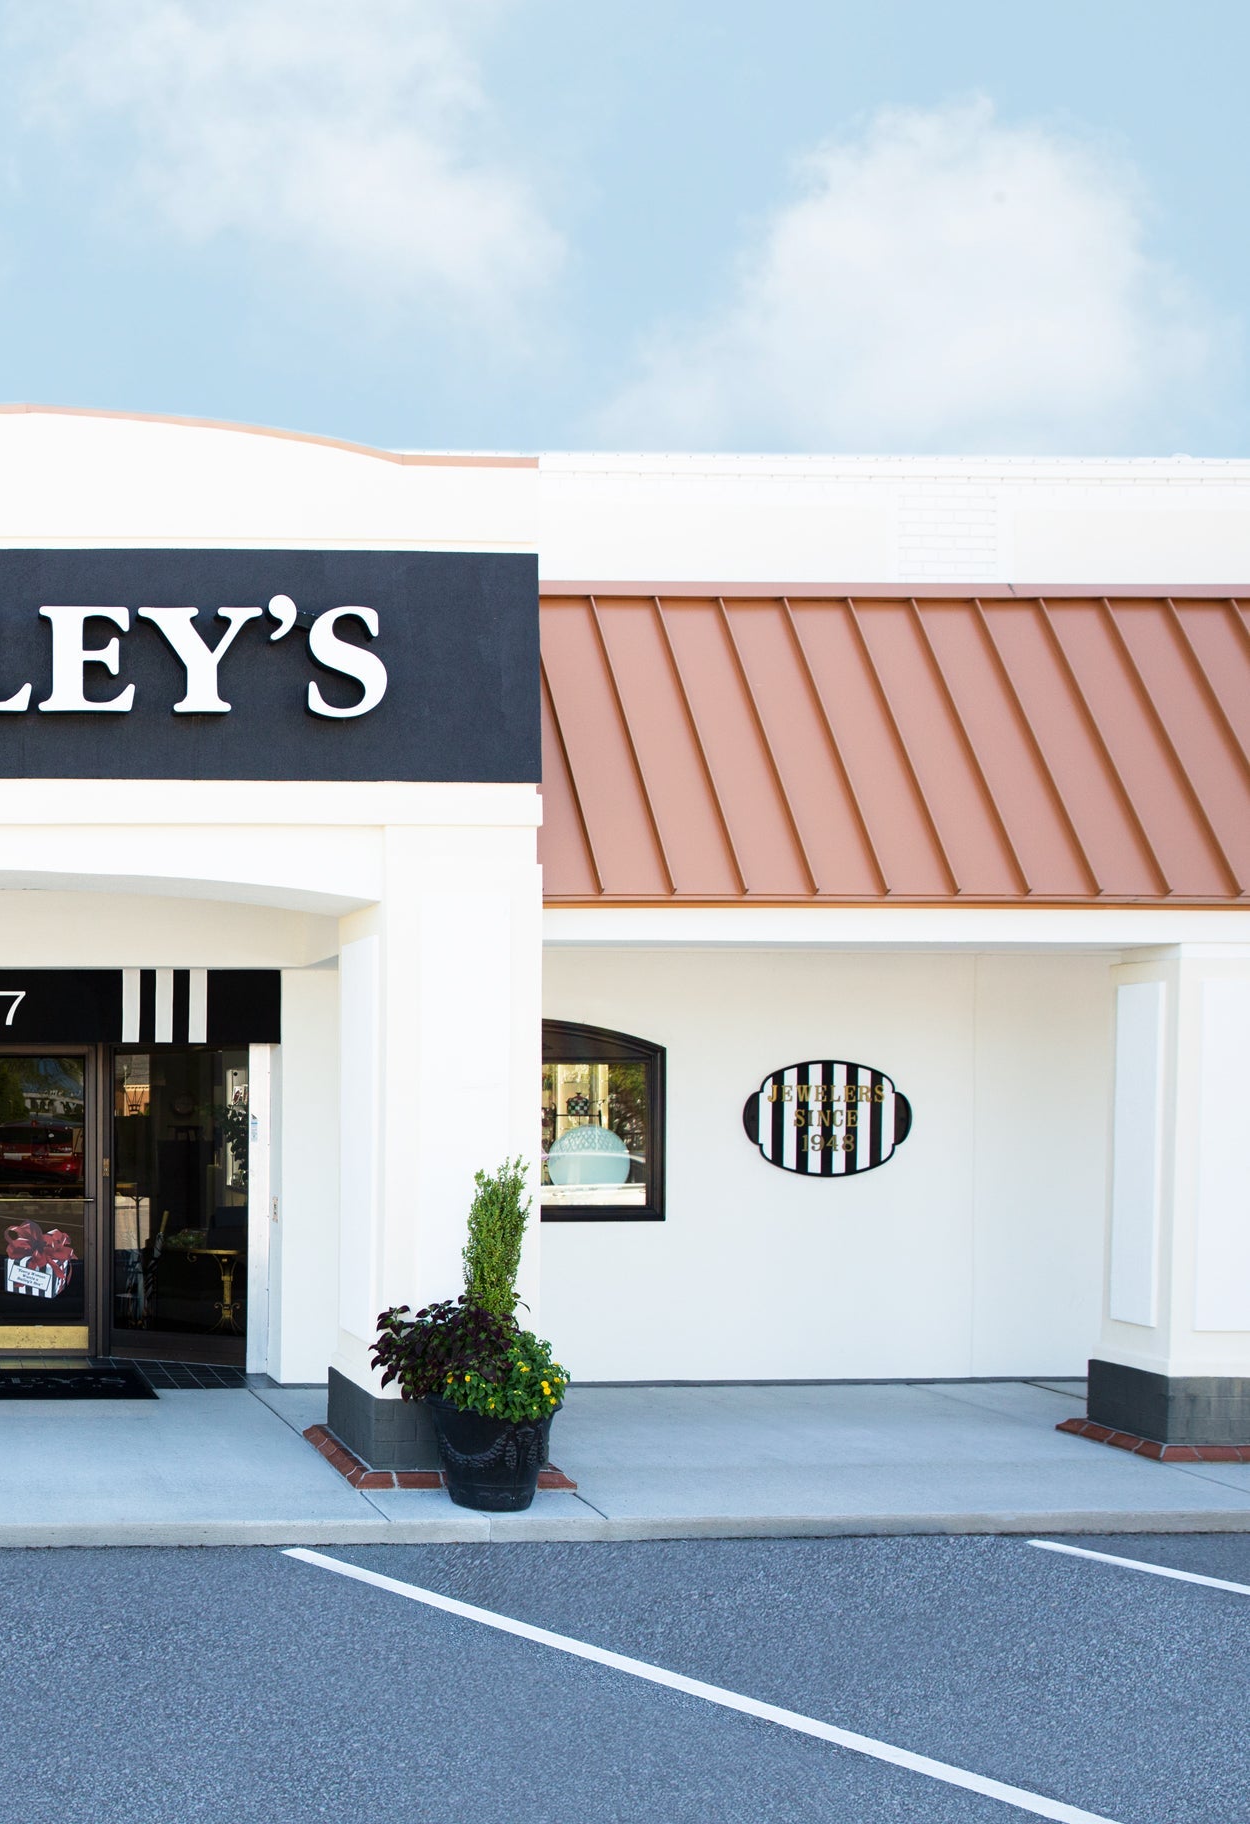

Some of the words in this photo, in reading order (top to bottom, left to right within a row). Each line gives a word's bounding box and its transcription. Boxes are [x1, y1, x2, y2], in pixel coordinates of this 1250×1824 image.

[767, 1085, 886, 1103] JEWELERS
[794, 1109, 859, 1127] SINCE
[801, 1134, 855, 1152] 1948
